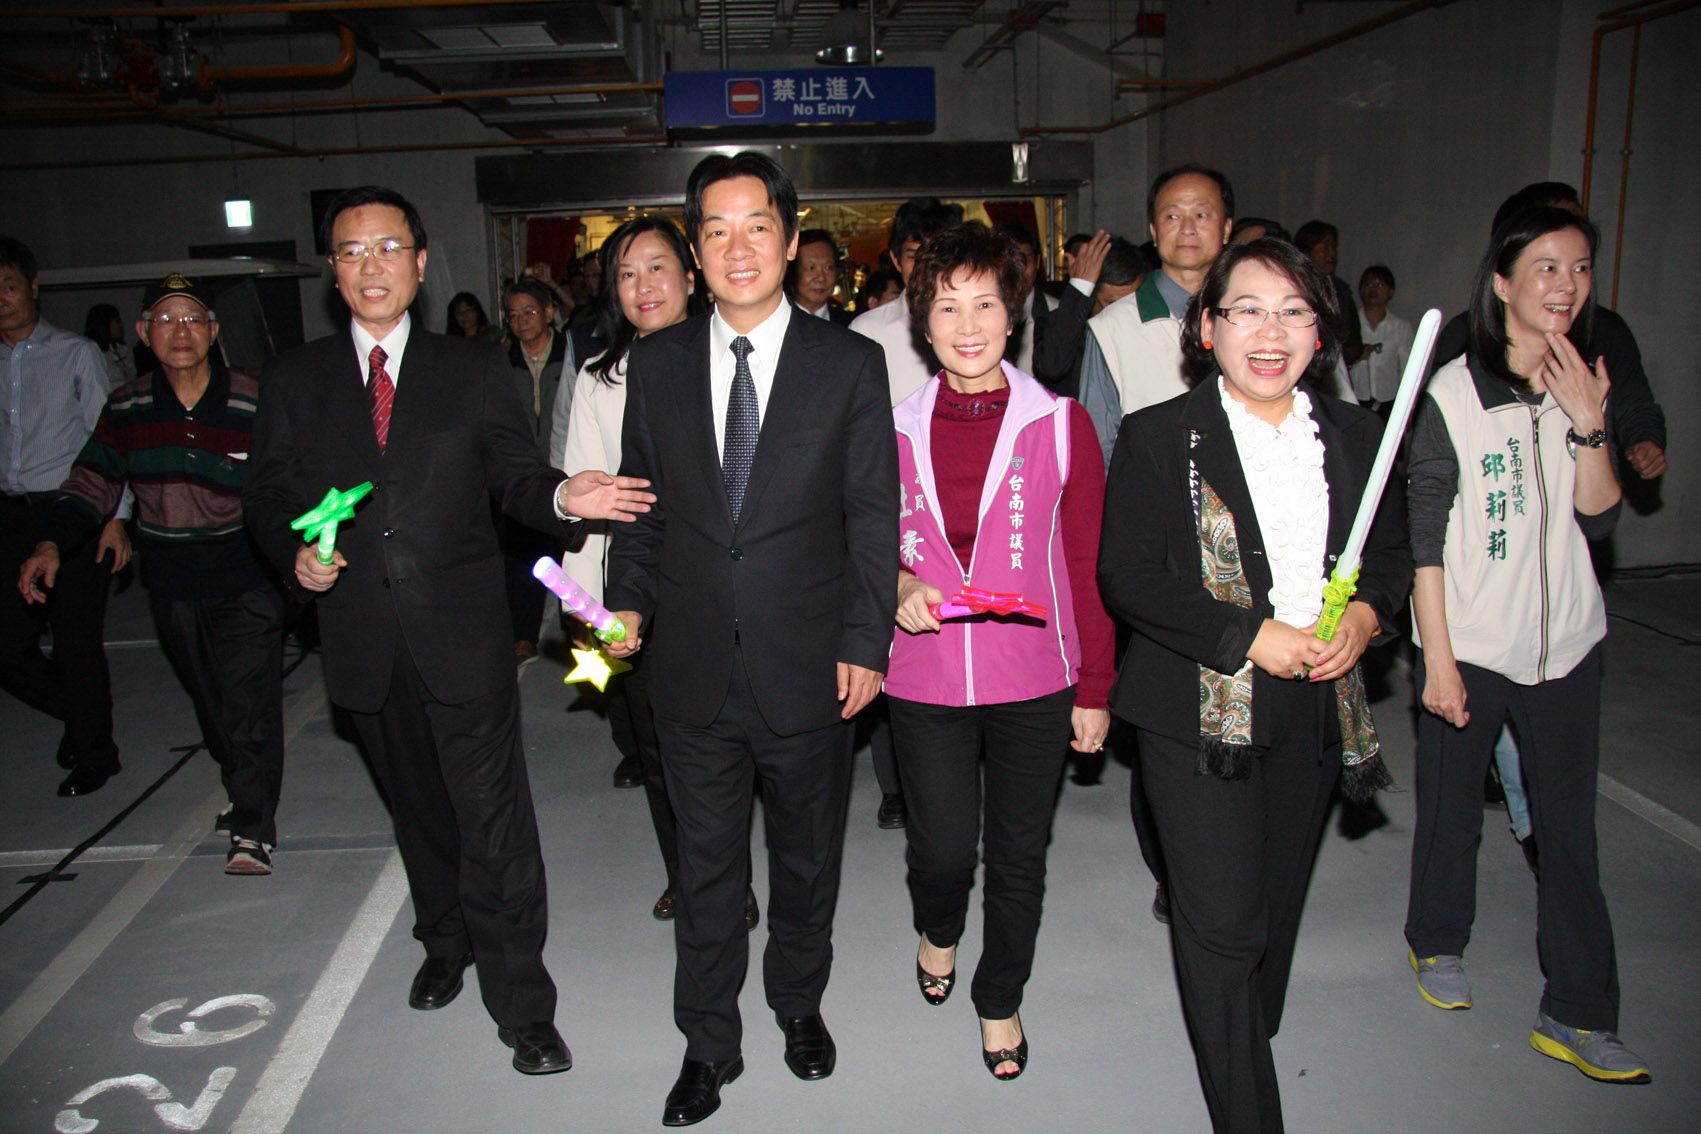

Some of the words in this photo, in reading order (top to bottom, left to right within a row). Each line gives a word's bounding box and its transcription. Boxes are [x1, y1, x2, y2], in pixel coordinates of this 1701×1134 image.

[772, 77, 875, 101] 禁止進入
[793, 103, 813, 115] No
[818, 103, 856, 117] Entry
[1480, 453, 1507, 561] 邱莉莉
[1506, 437, 1525, 516] 台南市議員
[1008, 474, 1025, 570] 台南市議員
